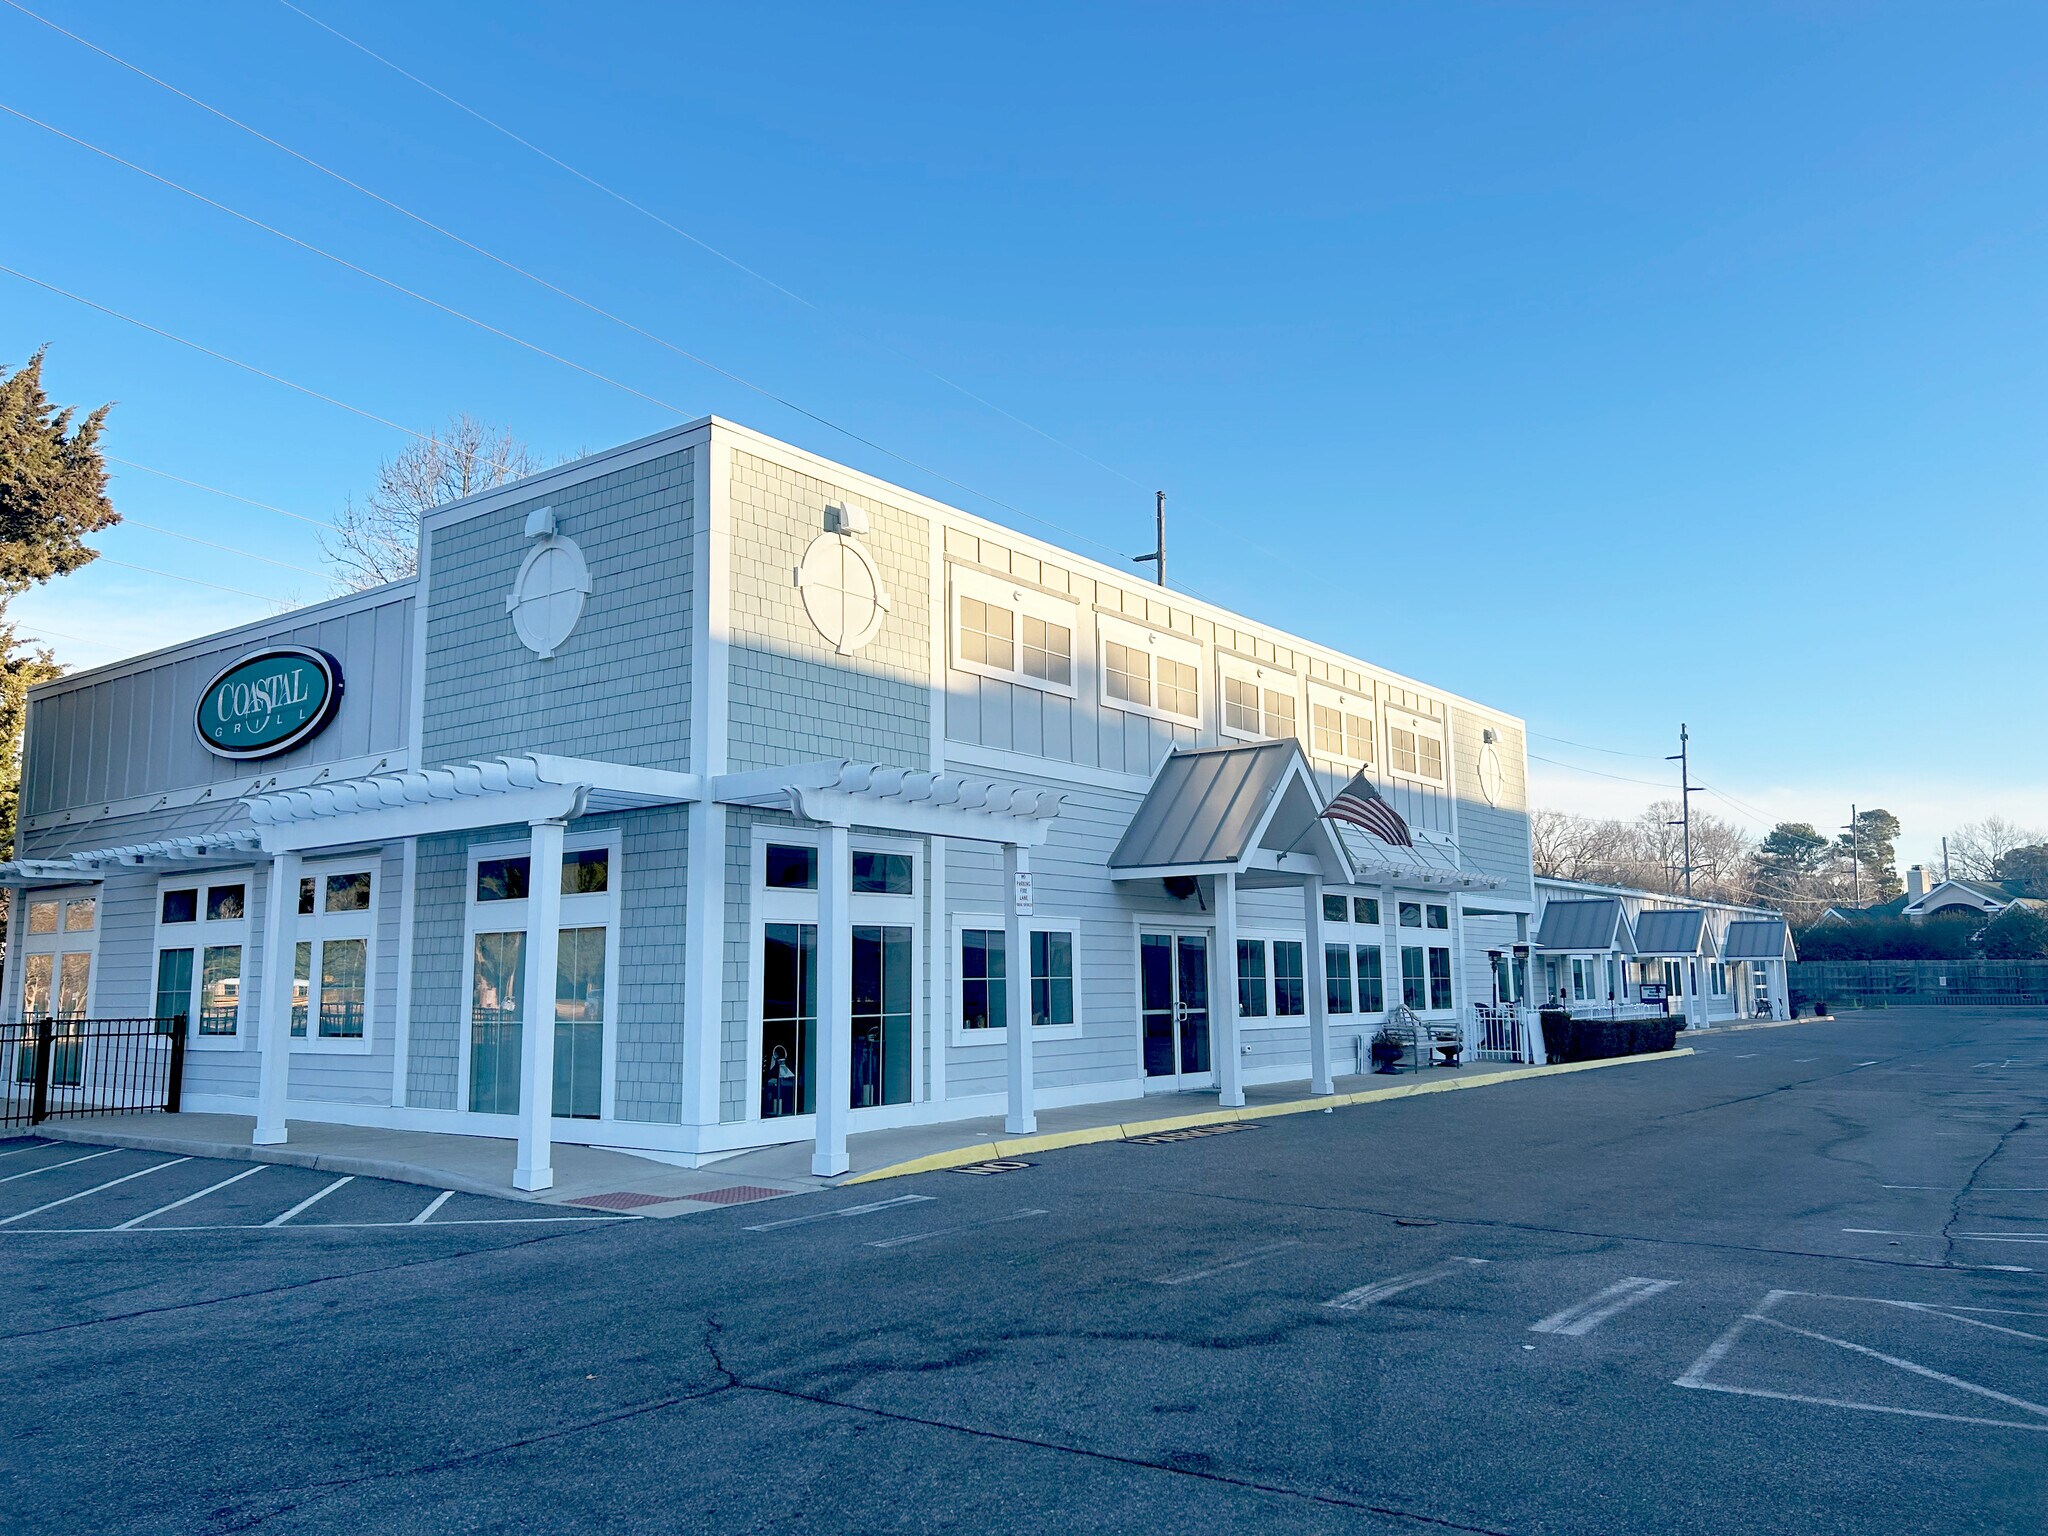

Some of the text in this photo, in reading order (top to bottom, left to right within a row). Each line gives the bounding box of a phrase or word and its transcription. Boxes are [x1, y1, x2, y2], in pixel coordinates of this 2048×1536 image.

[217, 669, 309, 722] COASTAL
[215, 709, 306, 738] GRILL
[951, 1123, 1262, 1176] NO PARKING
